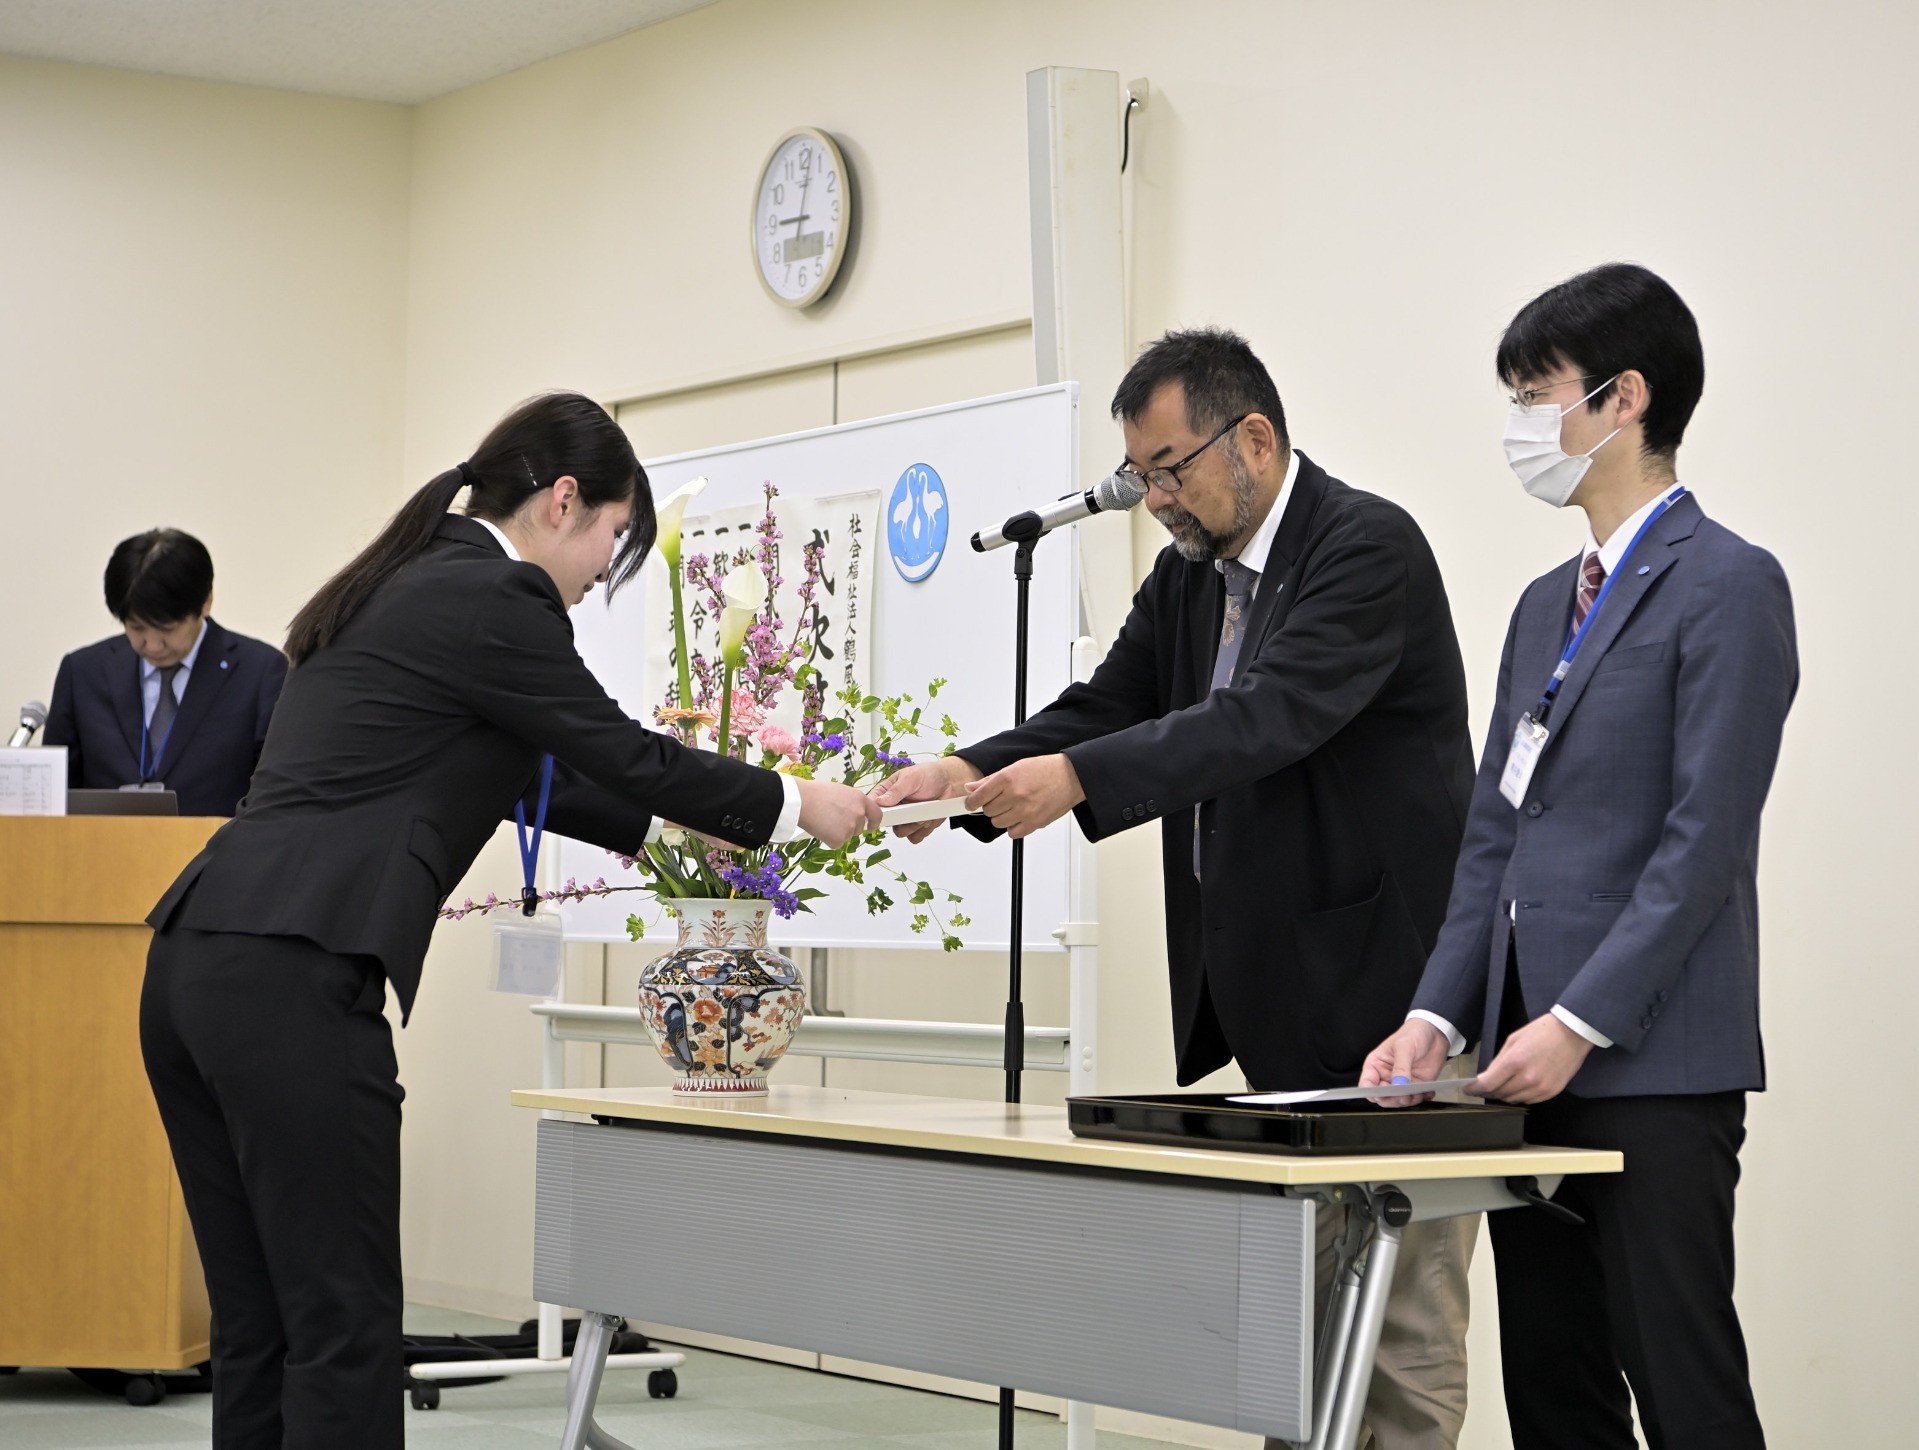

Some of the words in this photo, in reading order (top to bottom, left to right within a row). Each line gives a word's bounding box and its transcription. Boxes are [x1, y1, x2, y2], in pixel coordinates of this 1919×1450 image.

[785, 159, 794, 181] 11
[817, 152, 822, 174] 1
[826, 170, 837, 193] 2
[771, 183, 785, 206] 10
[831, 199, 839, 222] 3
[768, 214, 778, 236] 9
[826, 231, 834, 249] 4
[772, 242, 781, 264] 8
[784, 263, 792, 284] 7
[799, 265, 807, 288] 6
[815, 256, 823, 278] 5
[843, 513, 862, 775] 社会福祉法人鶴風入職式
